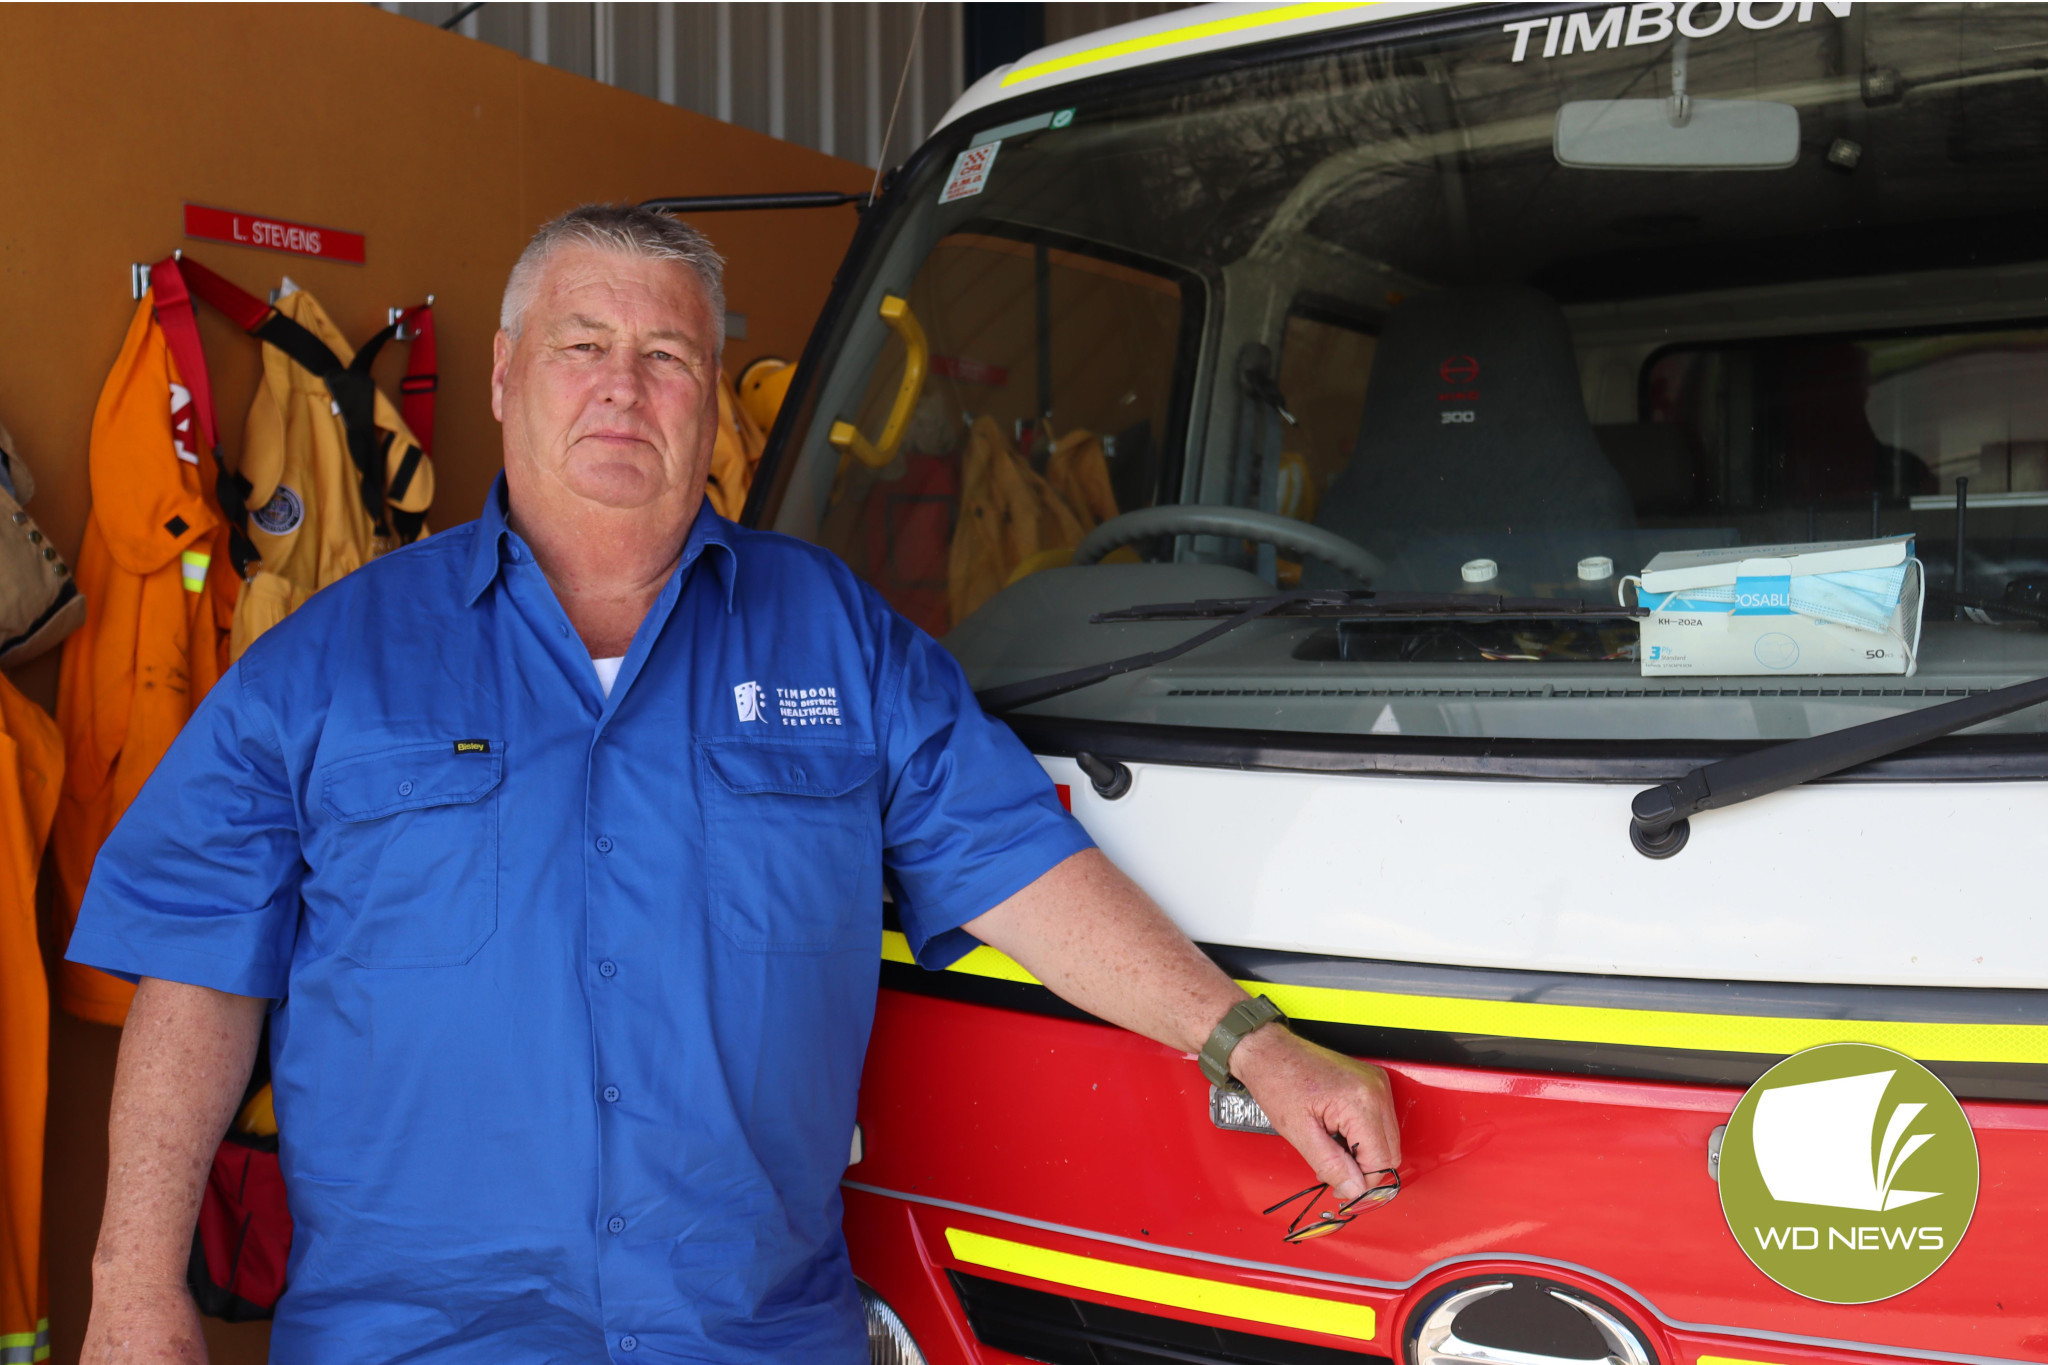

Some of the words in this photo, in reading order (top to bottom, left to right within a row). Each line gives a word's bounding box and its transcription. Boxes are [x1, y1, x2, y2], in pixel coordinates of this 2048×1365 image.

[233, 217, 248, 241] L.
[252, 221, 322, 254] STEVENS
[1441, 410, 1476, 424] 300
[1658, 618, 1703, 626] KH-202A
[1649, 645, 1661, 660] 3
[1865, 649, 1885, 660] 50
[776, 686, 837, 700] TIMBOON
[779, 699, 798, 708] AND
[800, 698, 837, 708] DISTRICT
[780, 706, 840, 717] HEALTHCARE
[782, 717, 842, 726] SERVICE
[457, 743, 484, 751] Bisley
